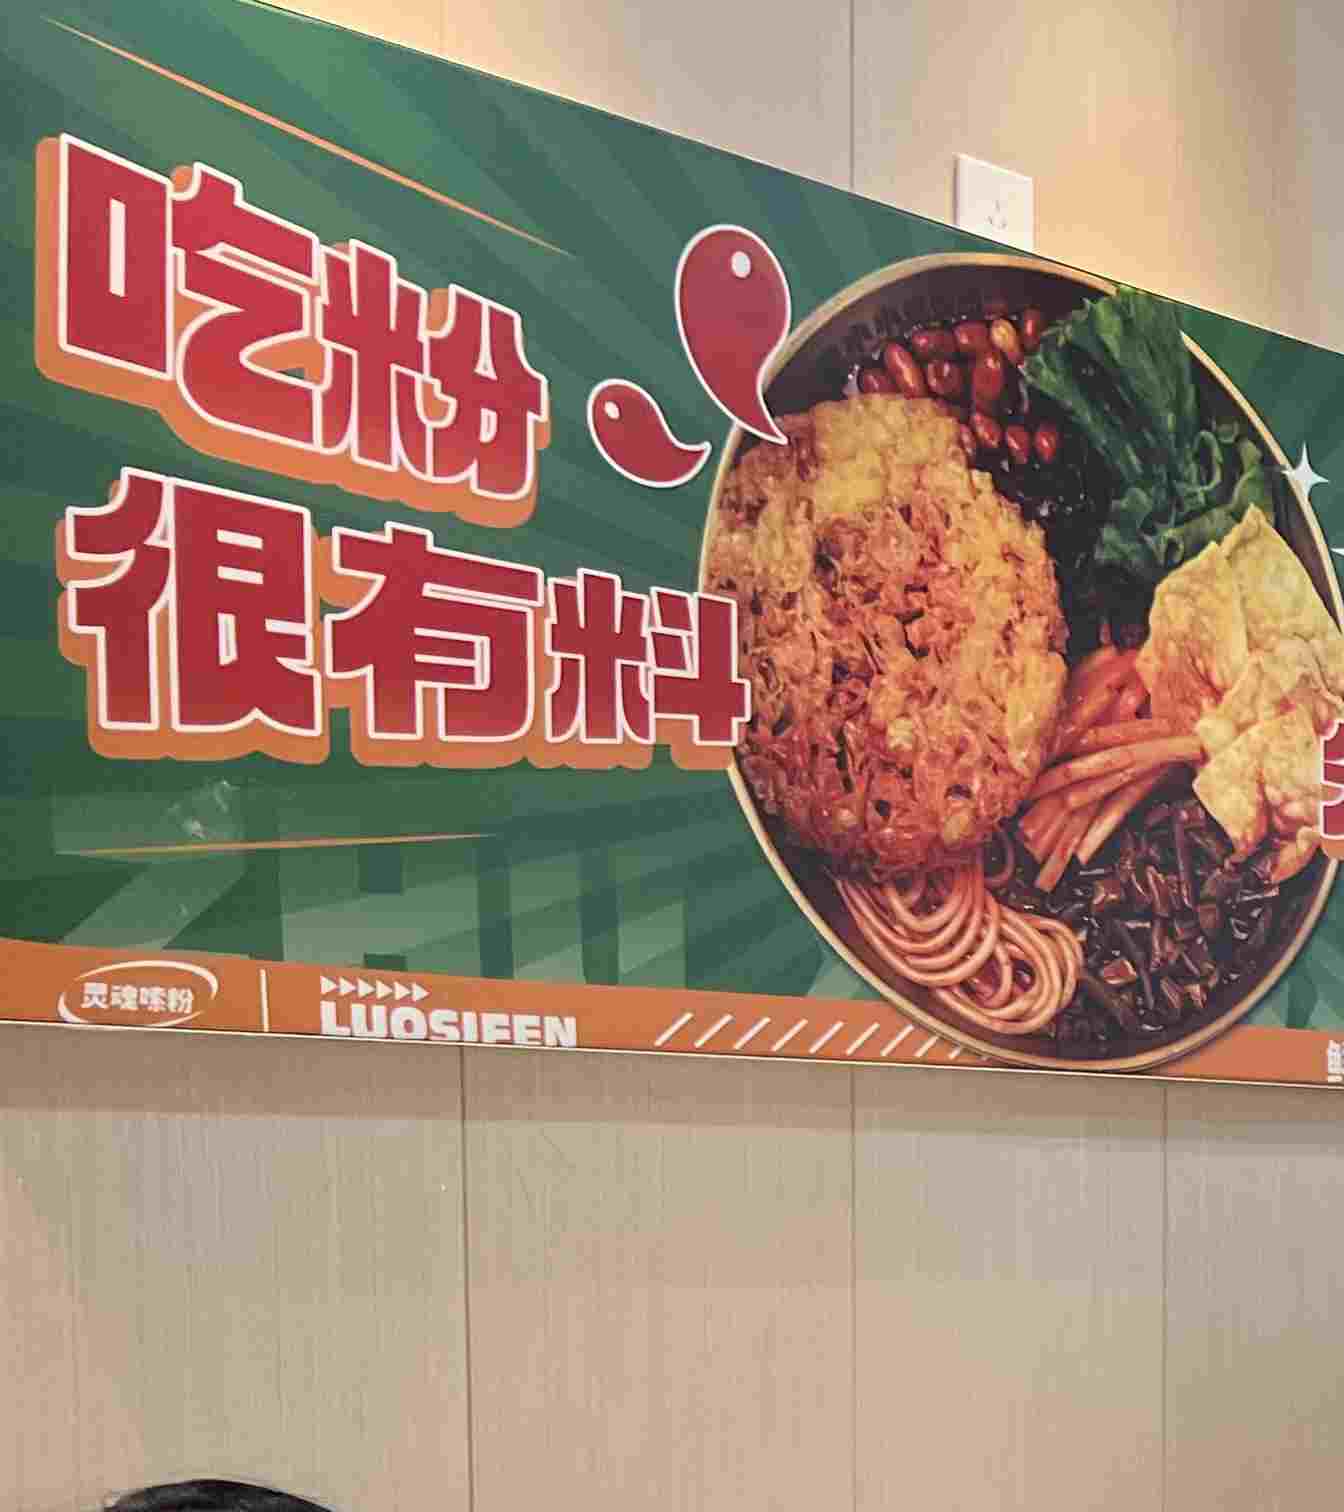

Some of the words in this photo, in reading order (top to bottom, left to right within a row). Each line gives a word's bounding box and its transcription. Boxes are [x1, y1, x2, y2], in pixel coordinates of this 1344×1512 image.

[56, 133, 548, 502] 吃粉
[66, 467, 751, 746] 很有料
[320, 1000, 577, 1047] LUOSIFEN
